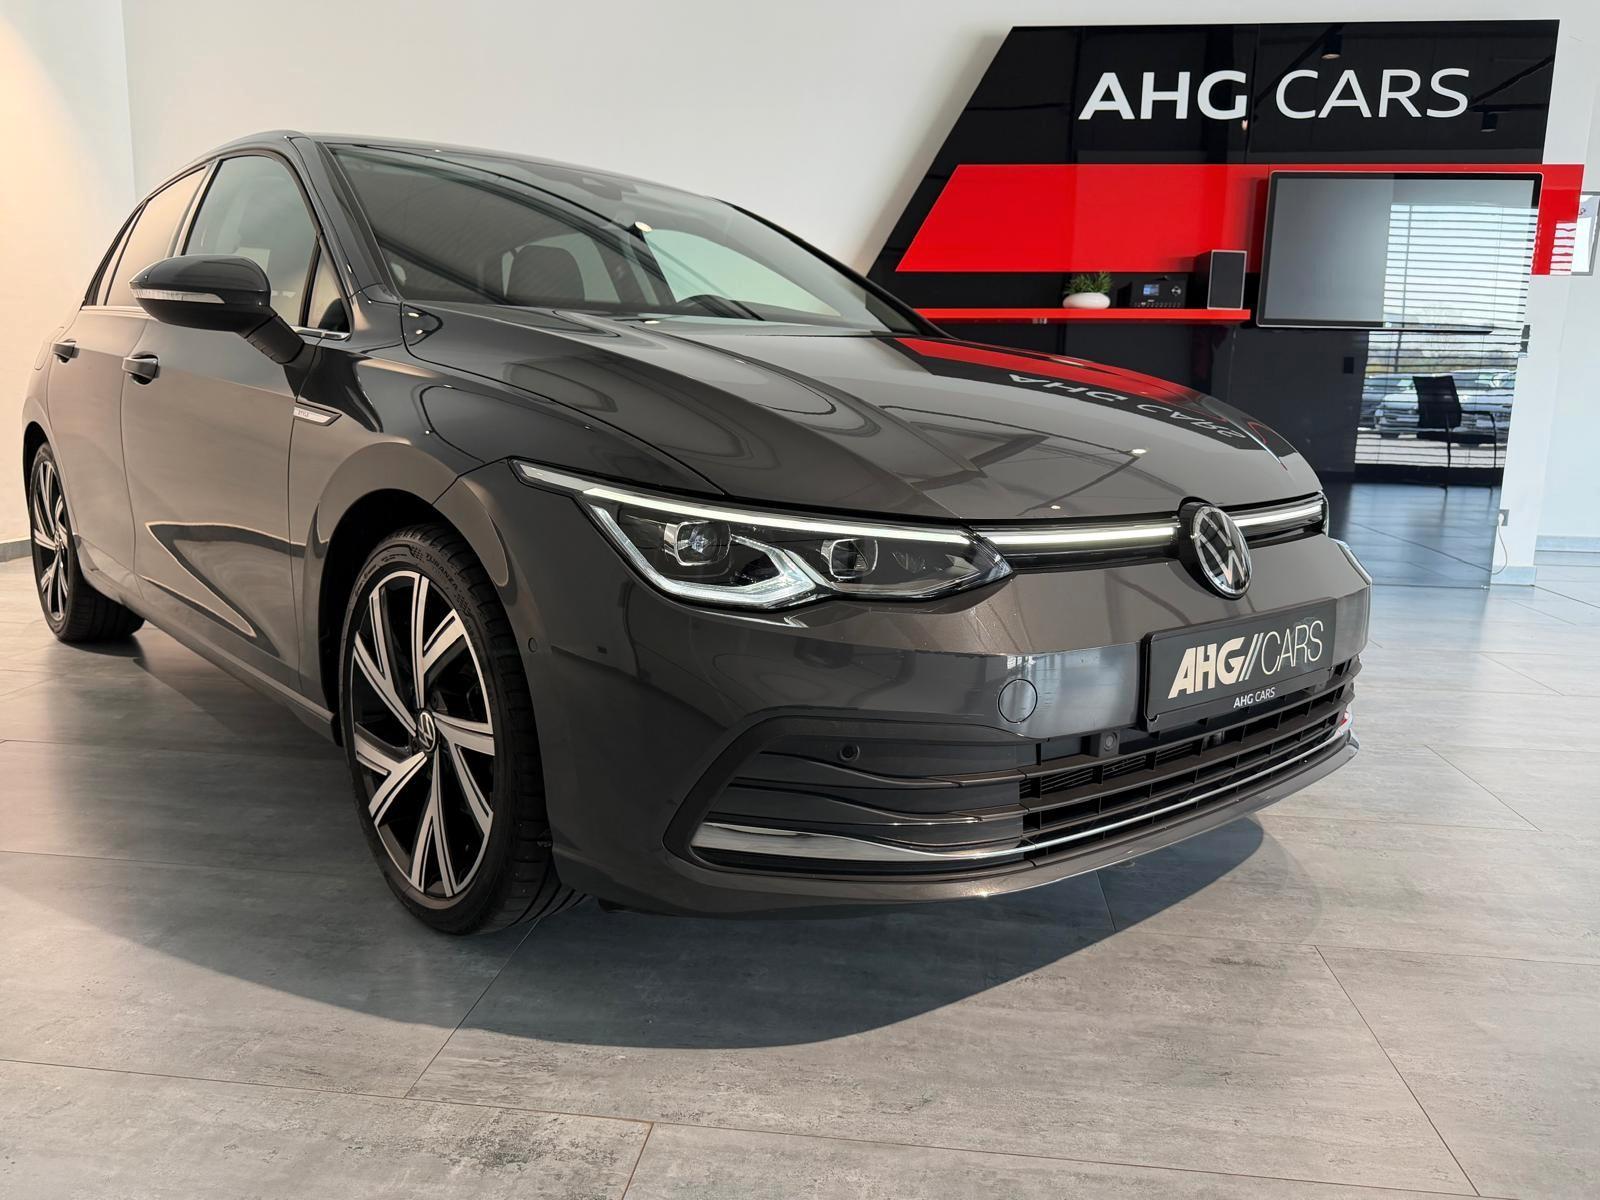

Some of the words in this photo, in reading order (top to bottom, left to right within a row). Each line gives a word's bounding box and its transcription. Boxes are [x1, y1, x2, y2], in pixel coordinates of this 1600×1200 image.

[1078, 71, 1247, 120] AHG
[1275, 68, 1470, 119] CARS
[1233, 692, 1254, 709] AHG
[1255, 687, 1276, 703] CARS
